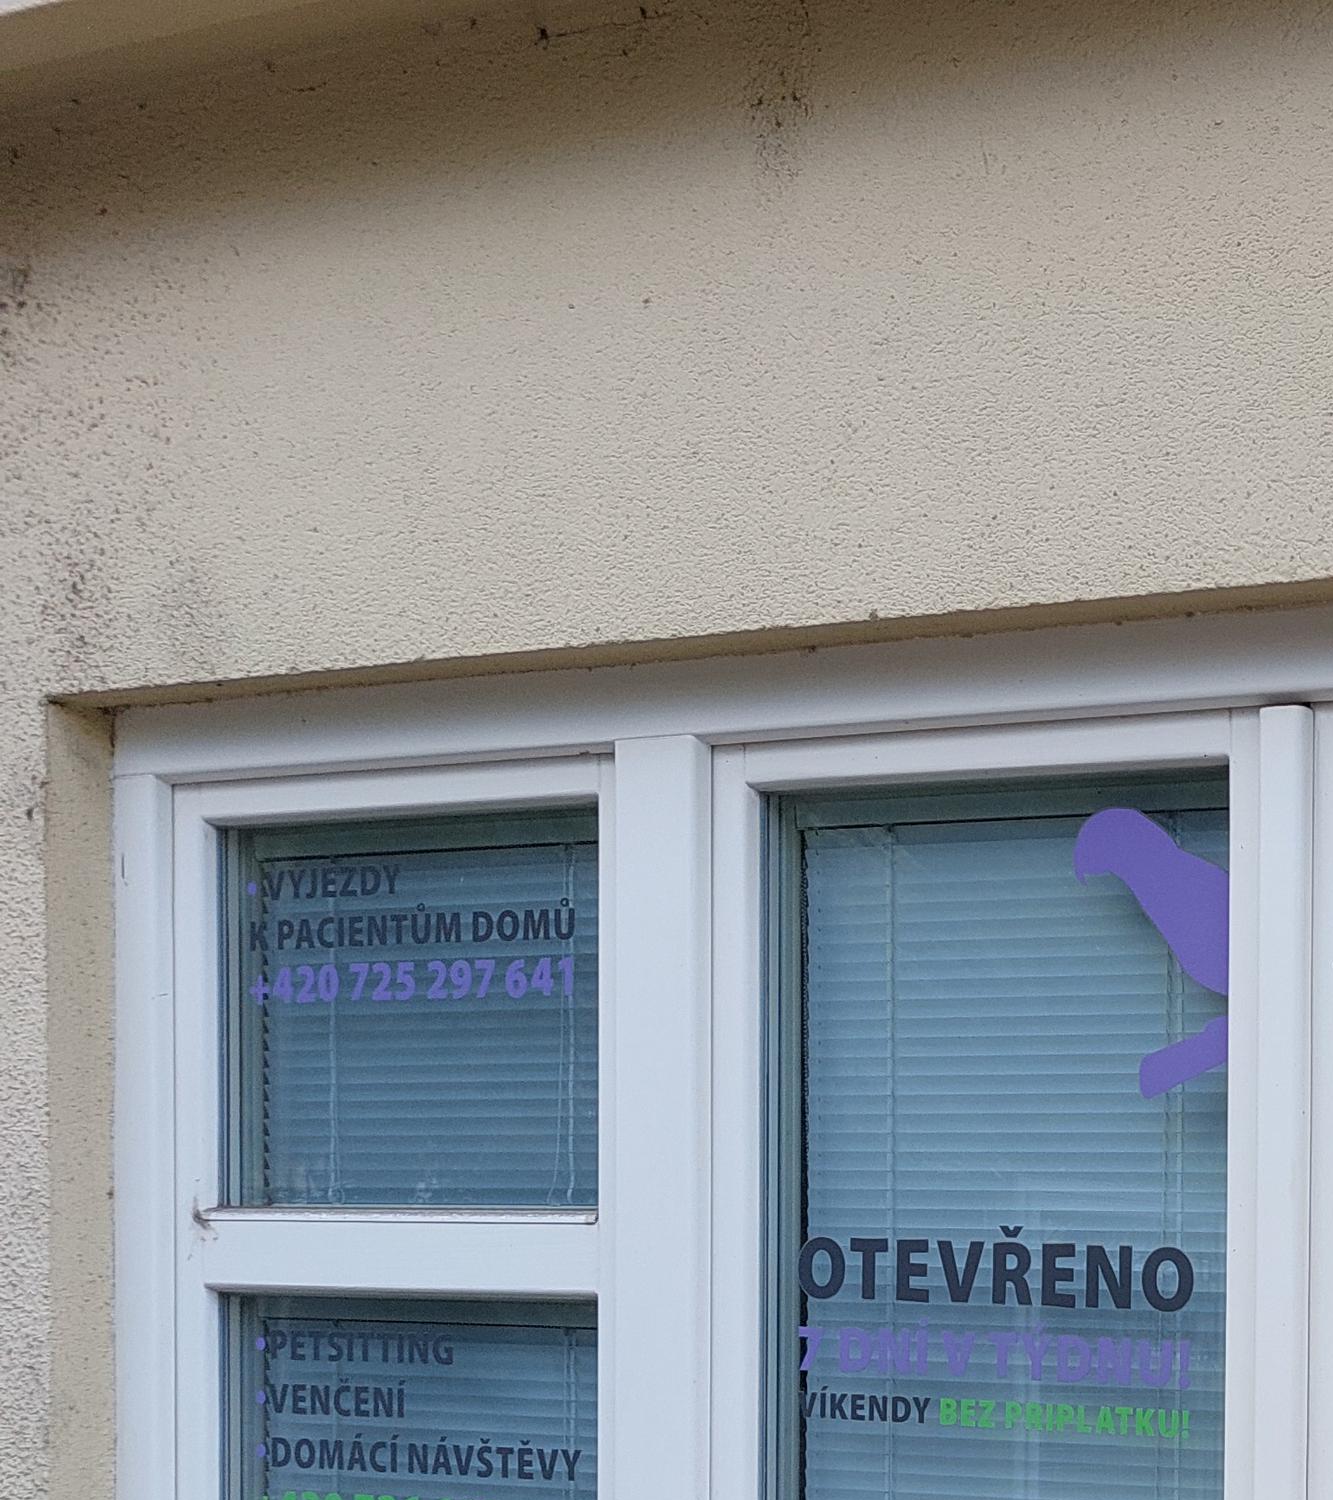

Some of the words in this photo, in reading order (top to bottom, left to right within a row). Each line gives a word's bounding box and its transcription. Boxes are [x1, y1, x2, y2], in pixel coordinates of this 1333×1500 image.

[251, 921, 268, 950] K
[277, 903, 462, 949] PACIENTŮM
[472, 898, 575, 942] DOMŮ
[251, 964, 339, 1004] +420
[350, 961, 415, 1001] 725
[427, 959, 495, 999] 297
[505, 957, 574, 999] 641
[800, 1225, 1193, 1312] OTEVŘENO
[270, 1331, 454, 1365] PETSITTING
[798, 1325, 824, 1371] 7
[270, 1379, 405, 1418] VENČENÍ
[800, 1385, 931, 1423] VÍKENDY
[939, 1397, 996, 1428] BEZ
[271, 1434, 398, 1473] DOMÁCÍ
[408, 1436, 583, 1481] NÁVŠTĚVY
